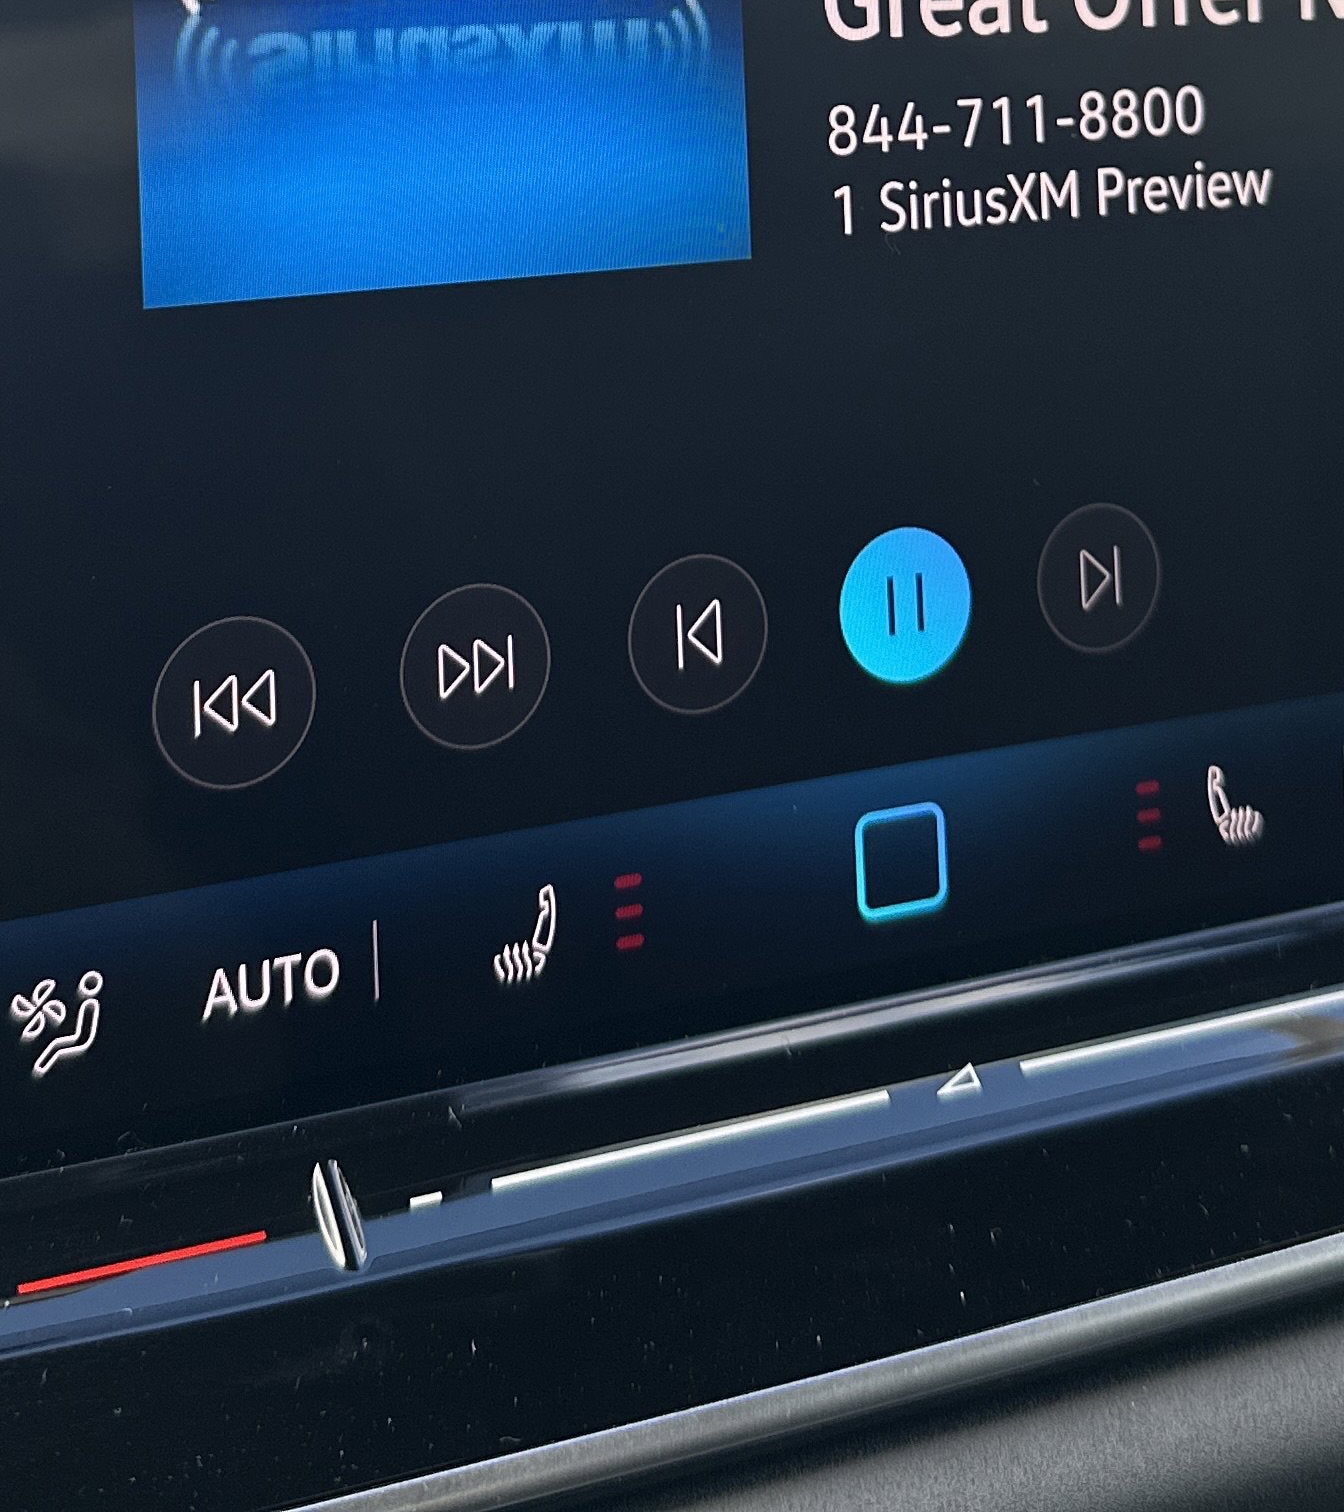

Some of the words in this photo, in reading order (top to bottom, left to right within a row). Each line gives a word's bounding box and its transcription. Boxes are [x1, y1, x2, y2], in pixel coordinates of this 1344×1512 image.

[828, 84, 1205, 156] 844-711-8800
[834, 185, 853, 235] 1
[880, 169, 1080, 233] SiriusXM
[1097, 160, 1272, 216] Preview
[202, 948, 340, 1021] AUTO
